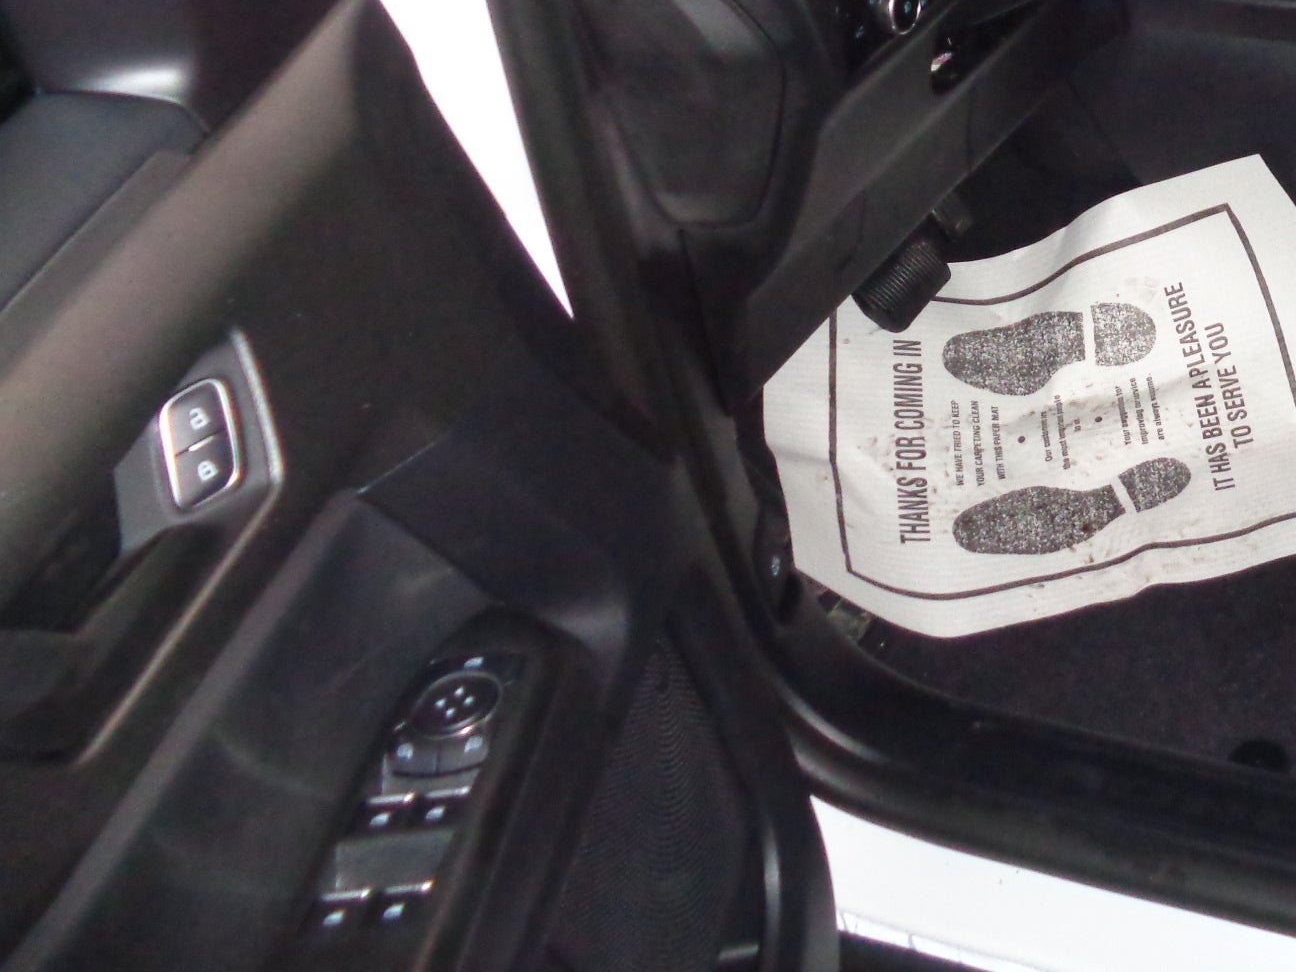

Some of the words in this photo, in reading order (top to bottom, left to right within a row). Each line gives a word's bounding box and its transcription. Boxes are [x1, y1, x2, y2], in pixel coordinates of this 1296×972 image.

[1164, 281, 1210, 379] PLEASURE
[892, 339, 922, 357] IN
[1204, 322, 1232, 365] YOU
[1114, 386, 1123, 396] for
[1191, 377, 1212, 390] A
[892, 362, 926, 430] COMING
[1217, 364, 1248, 422] SERVE
[950, 400, 960, 418] KEEP
[970, 400, 980, 424] CLEAN
[990, 406, 999, 421] MAT
[1194, 393, 1223, 440] BEEN
[952, 419, 960, 428] TO
[952, 430, 962, 452] TRIED
[992, 423, 1002, 445] PAPER
[1122, 430, 1132, 446] Your
[1156, 428, 1165, 440] are
[1230, 424, 1254, 449] TO
[895, 436, 927, 471] FOR
[972, 425, 983, 466] CARPETING
[994, 446, 1003, 462] THIS
[1059, 440, 1068, 456] most
[954, 454, 964, 472] HAVE
[1044, 449, 1053, 462] Our
[1062, 458, 1071, 470] the
[1205, 442, 1232, 474] HAS
[955, 475, 964, 486] WE
[976, 467, 985, 487] YOUR
[996, 463, 1006, 480] WITH
[1212, 476, 1236, 491] IT
[896, 476, 931, 544] THANKS
